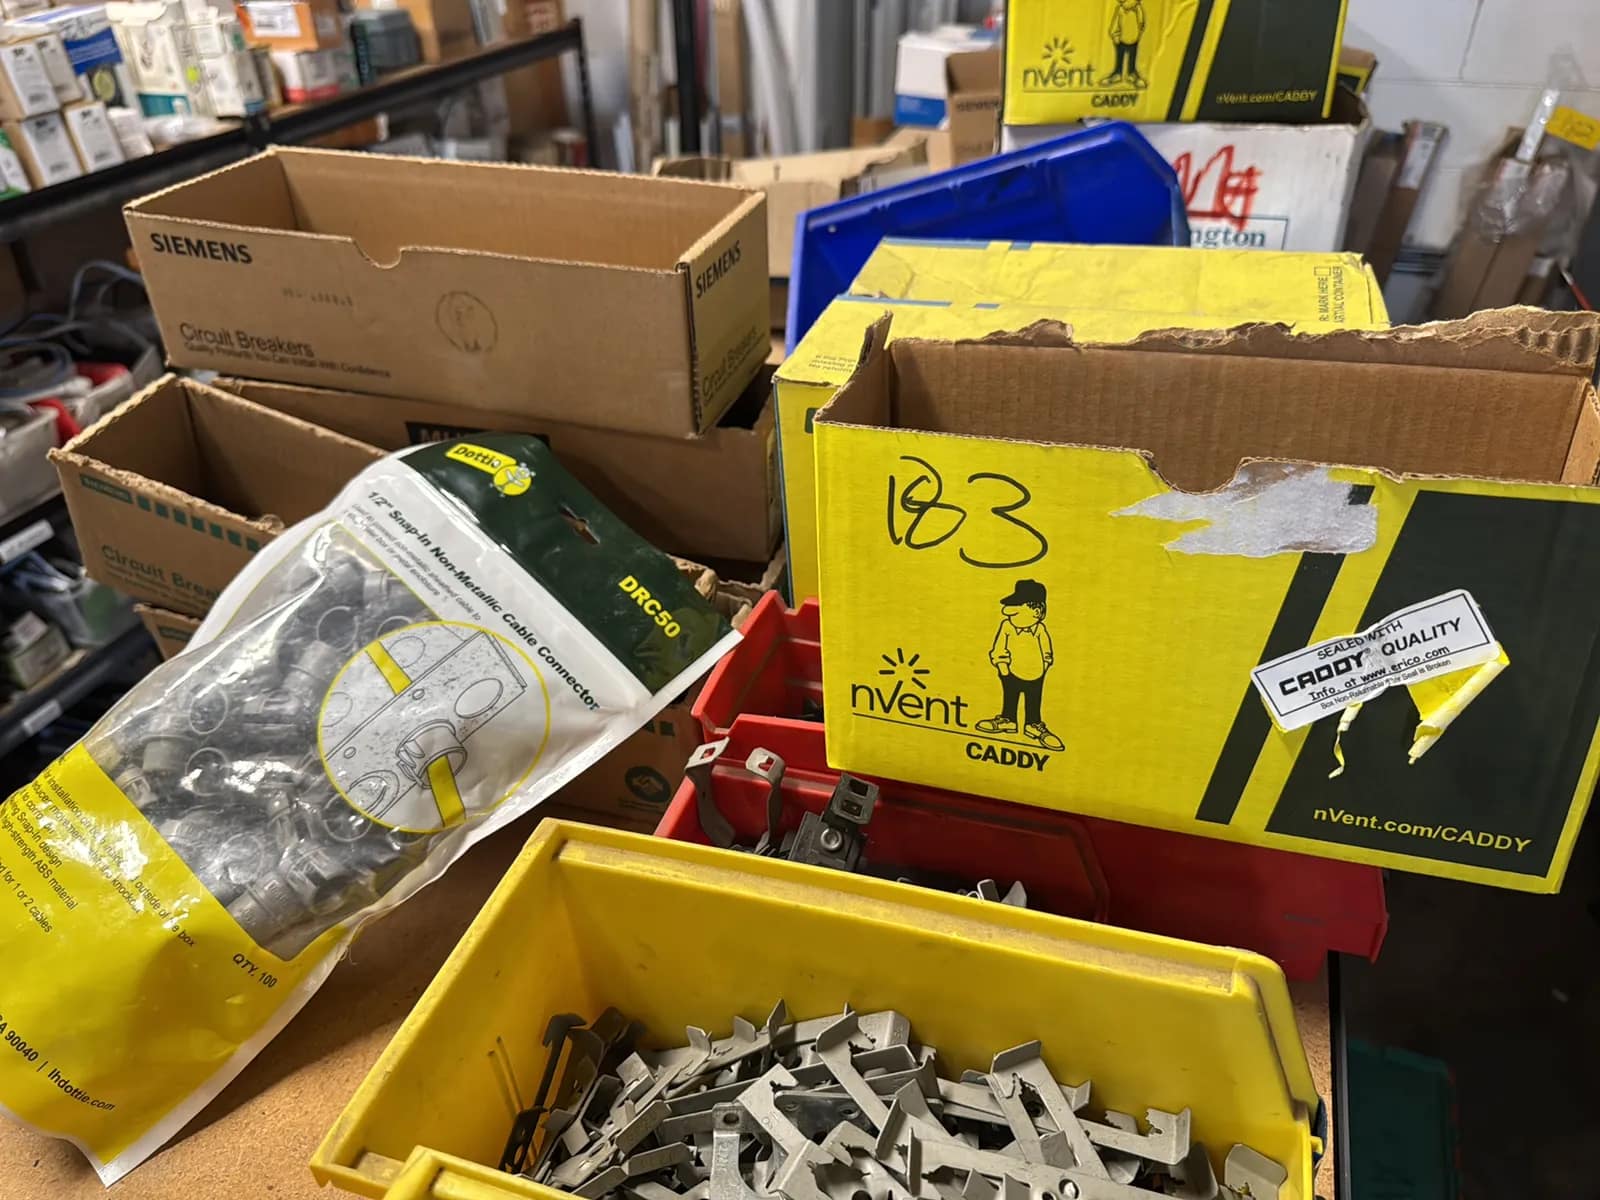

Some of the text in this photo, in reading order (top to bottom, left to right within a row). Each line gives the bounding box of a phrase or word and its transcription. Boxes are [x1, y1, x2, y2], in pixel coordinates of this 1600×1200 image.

[1022, 62, 1097, 88] nVent
[1091, 93, 1140, 108] CADDY
[150, 232, 253, 265] SIEMENS
[695, 239, 742, 299] SIEMENS
[179, 321, 316, 358] Circuit Breakers
[887, 455, 1049, 568] 183
[101, 544, 165, 581] Circuit
[389, 510, 432, 547] Snap-In
[430, 546, 503, 613] Non-Metallic
[502, 612, 538, 647] Cable
[537, 646, 601, 711] Connector
[618, 575, 681, 638] DRC50
[1317, 620, 1404, 660] SEALED WITH
[1381, 617, 1462, 656] QUALITY
[1309, 645, 1450, 702] Info. at www.erico.com
[1320, 700, 1335, 710] Box
[1401, 668, 1419, 681] Seal
[1424, 659, 1452, 672] Broken
[851, 680, 969, 728] nVent
[966, 741, 1050, 772] CADDY
[17, 811, 41, 843] Snap-In
[38, 841, 62, 868] design
[1313, 807, 1532, 853] nVent.com/CADDY
[32, 857, 53, 879] ABS
[49, 876, 79, 911] material
[47, 775, 82, 818] installation
[135, 880, 161, 910] outside
[159, 907, 170, 920] of
[178, 930, 196, 947] box
[2, 870, 16, 884] for
[12, 883, 21, 891] 1
[17, 890, 28, 900] or
[23, 898, 34, 907] 2
[29, 905, 53, 933] cables
[232, 953, 278, 988] QTY. 100
[4, 1030, 39, 1062] 90040
[47, 1068, 116, 1111] lhdottie.com
